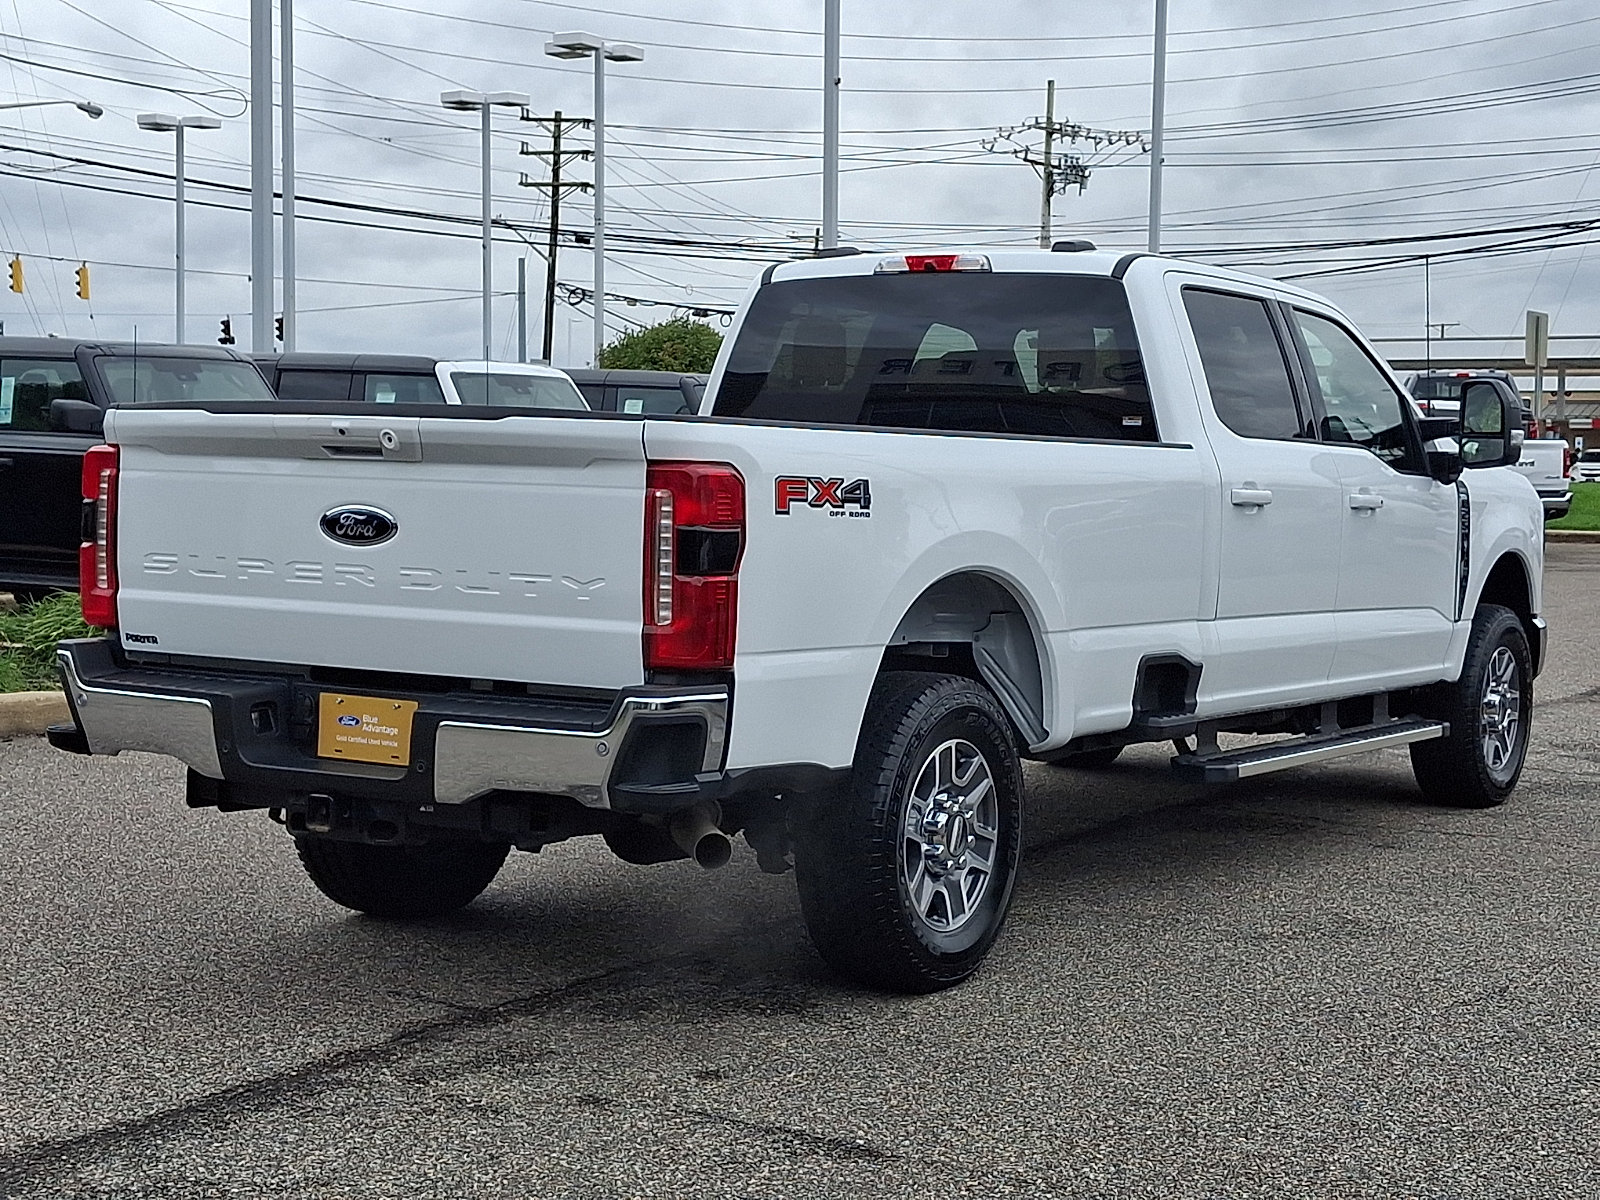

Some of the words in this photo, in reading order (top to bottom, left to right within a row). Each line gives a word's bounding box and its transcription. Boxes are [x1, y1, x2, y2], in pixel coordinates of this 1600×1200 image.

[775, 474, 871, 515] FX4
[335, 512, 379, 537] Ford
[143, 552, 375, 587] SUPER
[399, 566, 606, 600] DUTY
[340, 715, 358, 726] Ford
[362, 714, 379, 723] Blue
[361, 723, 399, 736] Advantage
[347, 736, 368, 744] Certified
[381, 739, 398, 747] Vehicle
